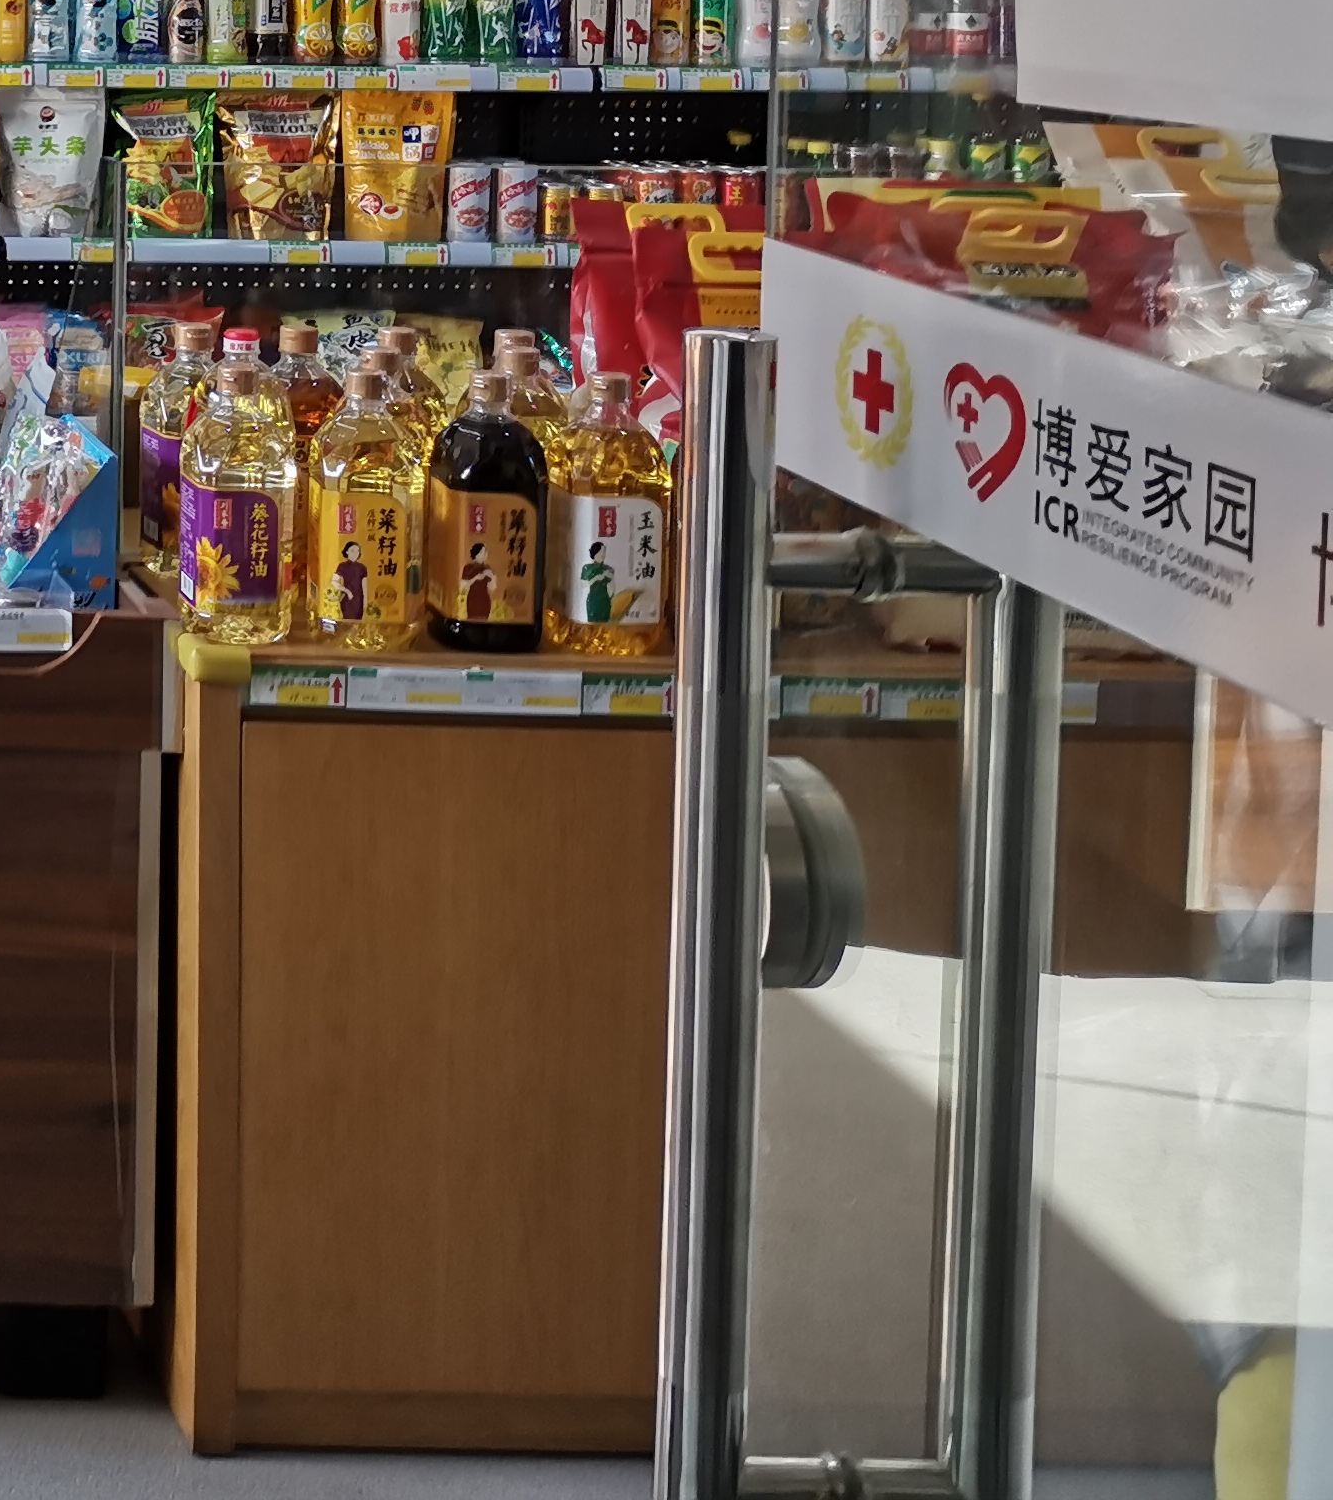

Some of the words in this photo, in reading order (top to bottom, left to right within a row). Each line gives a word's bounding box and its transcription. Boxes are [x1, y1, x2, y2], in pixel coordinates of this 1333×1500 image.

[12, 135, 87, 157] 芋头条
[1031, 398, 1257, 563] 博爱家园
[1033, 489, 1081, 542] ICR
[249, 502, 270, 579] 葵花籽油
[377, 507, 398, 578] 菜籽油
[636, 509, 658, 581] 玉米油
[1080, 530, 1158, 581] RESILIENCE
[1159, 561, 1233, 608] PROGRAM
[1081, 509, 1163, 556] INTEGRATED
[1164, 541, 1256, 594] COMMUNITY
